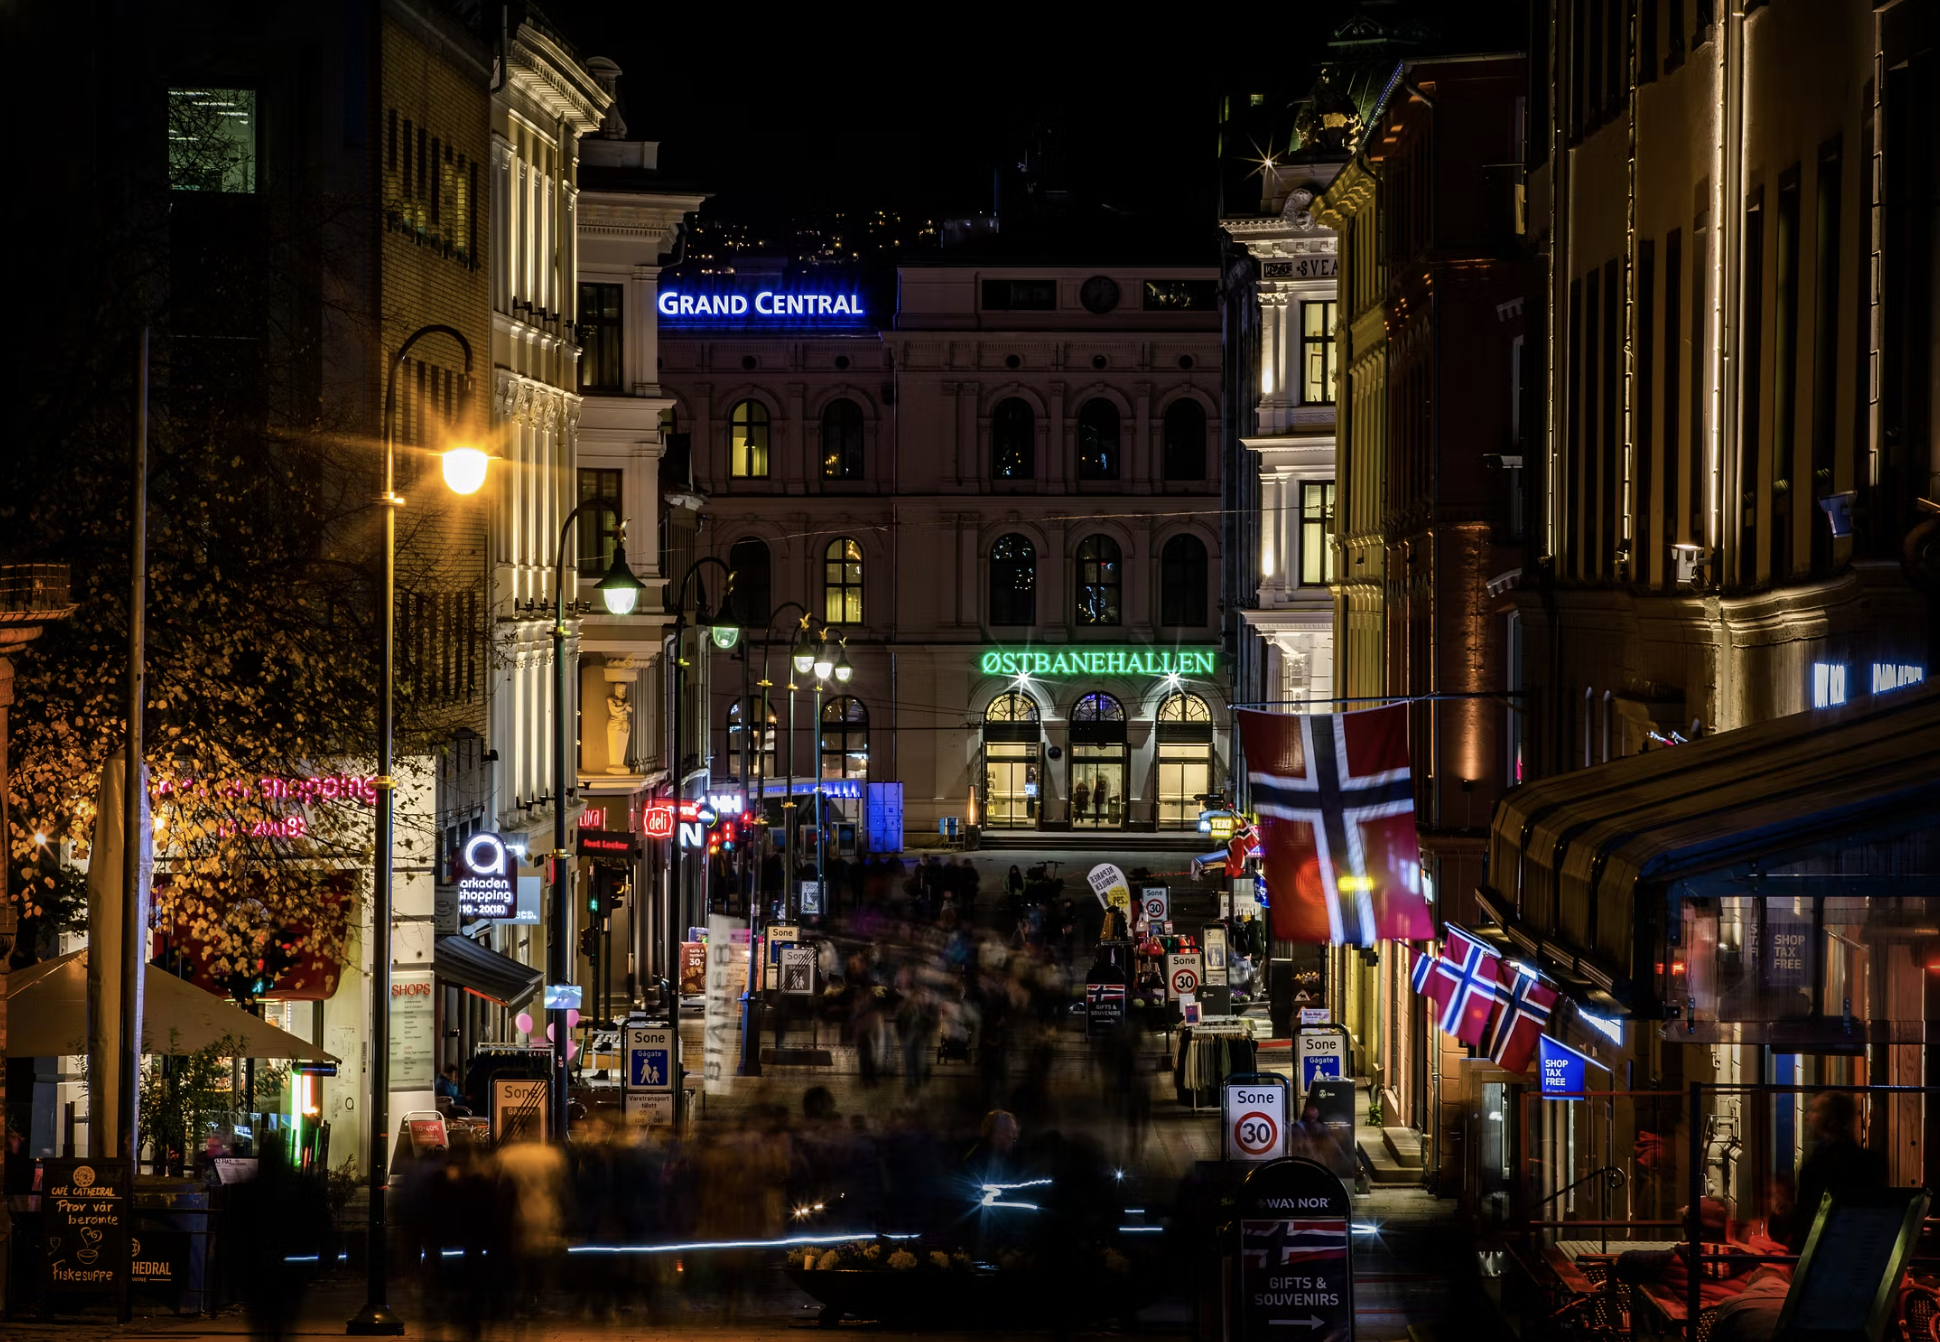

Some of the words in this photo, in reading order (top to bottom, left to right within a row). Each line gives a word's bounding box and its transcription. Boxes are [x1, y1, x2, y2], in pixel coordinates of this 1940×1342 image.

[658, 291, 748, 315] GRAND
[755, 291, 863, 315] CENTRAL
[982, 652, 1215, 674] ØSTBANEHALLEN
[649, 813, 667, 831] deli
[459, 877, 509, 889] arkaden
[1149, 902, 1162, 914] 30
[772, 928, 794, 937] Sone
[1774, 934, 1806, 946] SHOP
[1774, 946, 1796, 957] TAX
[1173, 956, 1196, 965] Sone
[1773, 958, 1803, 970] FREE
[1177, 975, 1194, 989] 30
[391, 983, 431, 997] SHOPS
[634, 1031, 666, 1044] Sone
[1305, 1039, 1337, 1050] Sone
[637, 1050, 662, 1059] Gågate
[1309, 1056, 1334, 1065] Gågate
[1545, 1059, 1569, 1068] SHOP
[1545, 1068, 1562, 1077] TAX
[1545, 1077, 1566, 1086] FREE
[1237, 1090, 1275, 1104] Sone
[1242, 1122, 1271, 1144] 30
[72, 1186, 116, 1198] CATHEDRAL
[1269, 1277, 1313, 1290] GIFTS
[1315, 1276, 1327, 1290] &
[1254, 1293, 1340, 1306] SOUVENIRS
